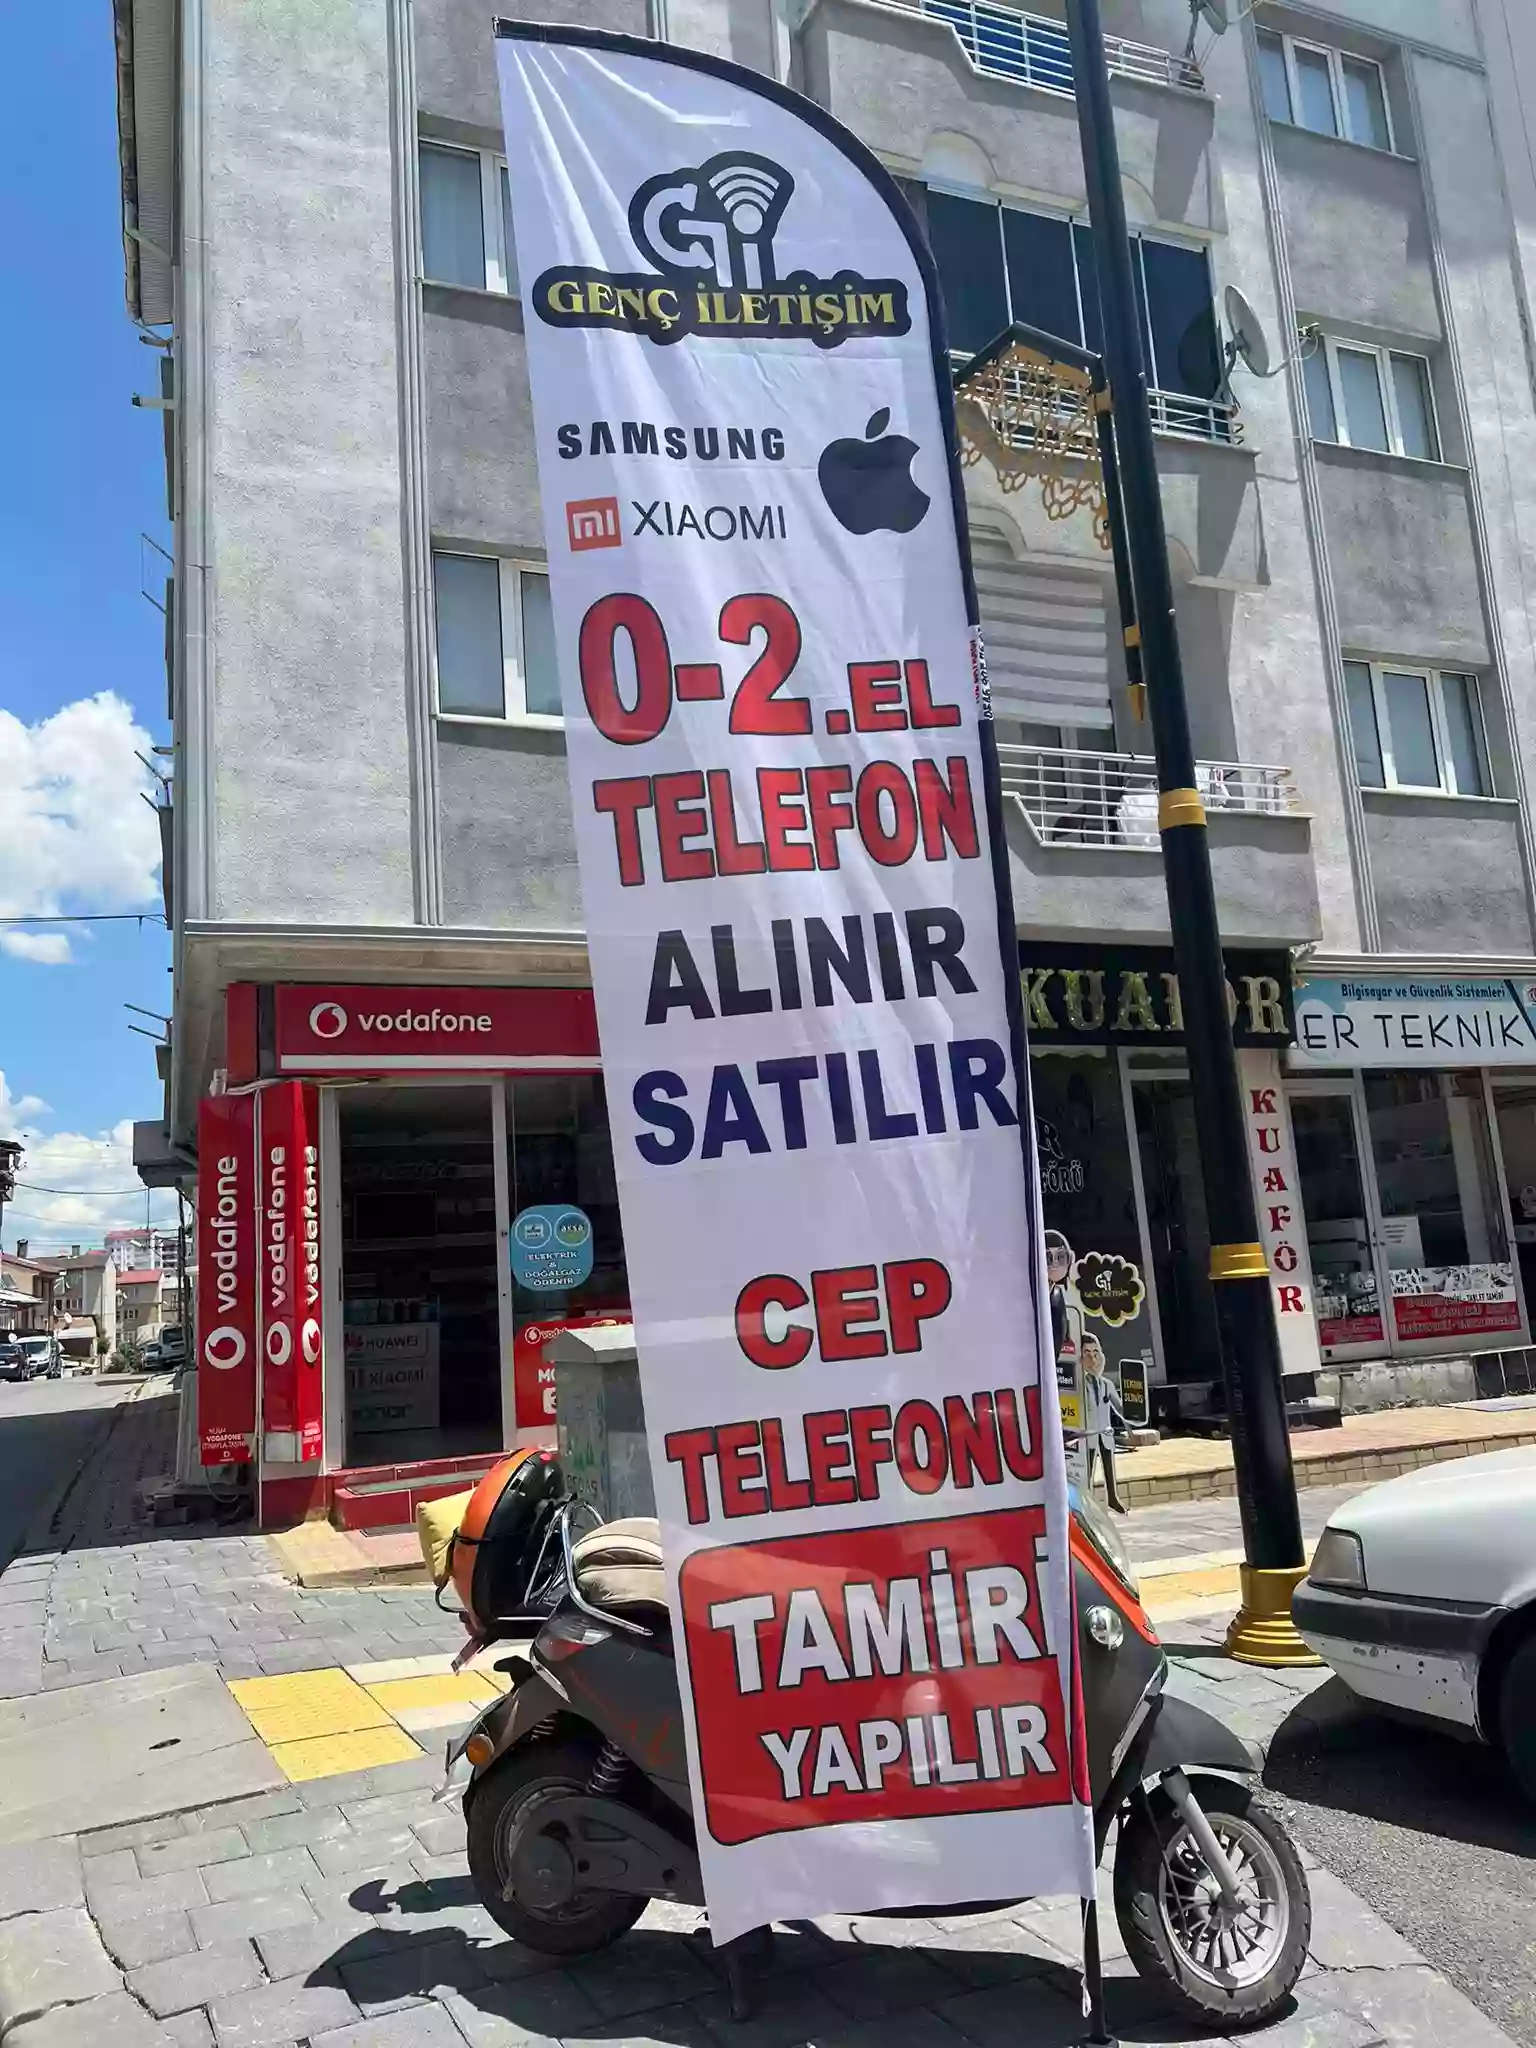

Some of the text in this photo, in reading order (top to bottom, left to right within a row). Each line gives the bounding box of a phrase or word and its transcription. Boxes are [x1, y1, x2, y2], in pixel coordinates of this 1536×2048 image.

[547, 281, 897, 334] GENÇ İLETİŞİM
[557, 421, 785, 461] SAMSUNG
[631, 500, 787, 541] XIAOMI
[592, 756, 980, 888] TELEFON
[644, 906, 978, 1025] ALINIR
[1020, 968, 1290, 1034] KUAR
[1341, 983, 1505, 1001] Bilgisayar ve Güvenlik Sistemleri
[357, 1008, 492, 1034] vodafone
[1303, 1014, 1359, 1049] ER
[632, 1037, 1020, 1166] SATILIR
[210, 1155, 238, 1314] vodafone
[267, 1146, 286, 1308] vodafone
[303, 1145, 319, 1306] vodafone
[1250, 1089, 1306, 1312] KUAFÖR
[366, 1335, 419, 1349] HUAWEI
[735, 1257, 952, 1370] CEP
[664, 1385, 1045, 1525] TELEFONU
[761, 1703, 1057, 1801] YAPILIR
